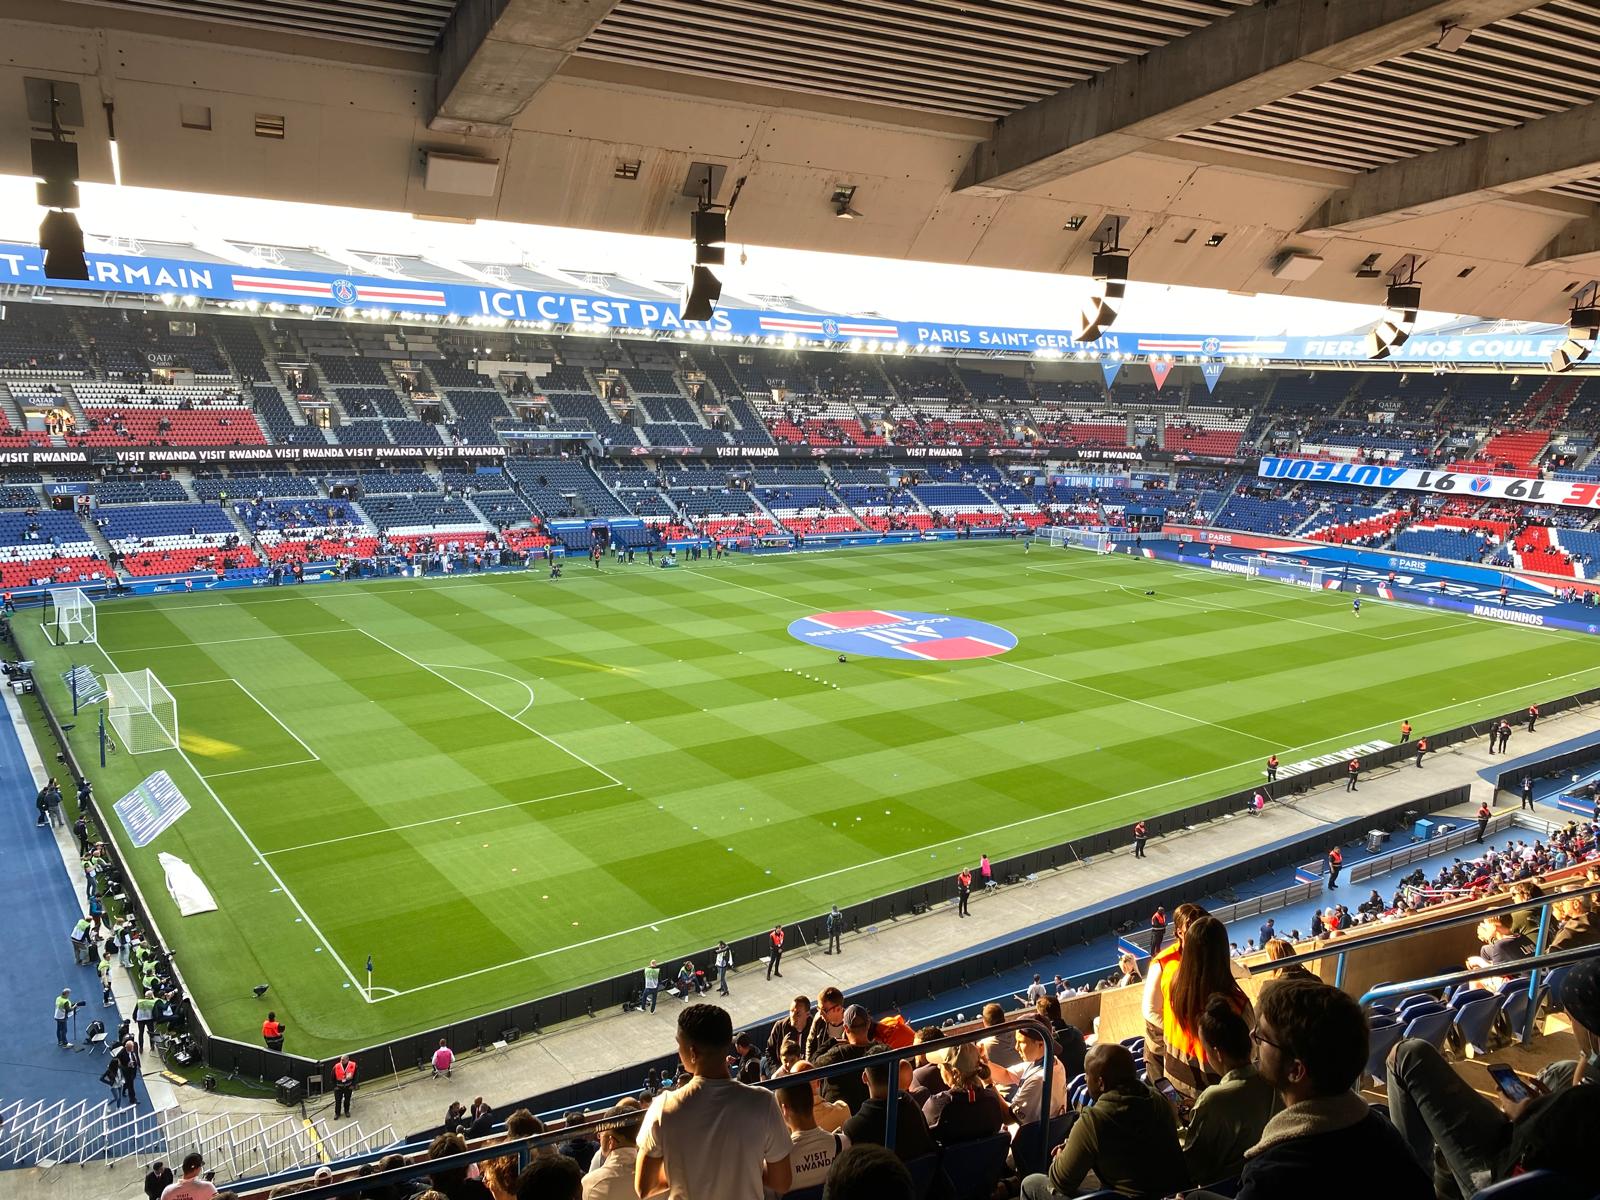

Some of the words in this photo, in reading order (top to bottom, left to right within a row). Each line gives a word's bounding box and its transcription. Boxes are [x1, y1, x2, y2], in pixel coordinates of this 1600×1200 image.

[0, 253, 214, 290] T-RMAIN
[480, 290, 527, 317] ICI
[537, 296, 631, 325] C'EST
[918, 328, 971, 344] PARIS
[1409, 340, 1463, 357] NOS
[28, 397, 54, 405] QATAR
[0, 452, 30, 463] VISIT
[33, 452, 87, 463] RWANDA
[117, 451, 146, 461] VISIT
[149, 450, 198, 461] RWANDA
[199, 450, 227, 460] VISIT
[229, 449, 273, 460] RWANDA
[275, 448, 300, 459] VISIT
[303, 448, 344, 458] RWANDA
[345, 448, 373, 457] VISIT
[376, 447, 424, 457] RWANDA
[425, 447, 455, 457] VISIT
[457, 447, 506, 456] RWANDA
[716, 447, 739, 457] VISIT
[741, 447, 780, 457] RWANDA
[906, 448, 926, 457] VISIT
[928, 448, 963, 457] RWANDA
[1077, 450, 1101, 459] VISIT
[1103, 451, 1143, 460] RWANDA
[1261, 456, 1406, 486] AUTEUIL
[1208, 532, 1232, 542] PARIS
[1211, 560, 1260, 576] MARQUINHOS
[1399, 558, 1427, 569] PARIS
[1473, 604, 1544, 626] MARQUINHOS
[803, 1150, 828, 1163] VISIT
[795, 1156, 835, 1174] RWAND
